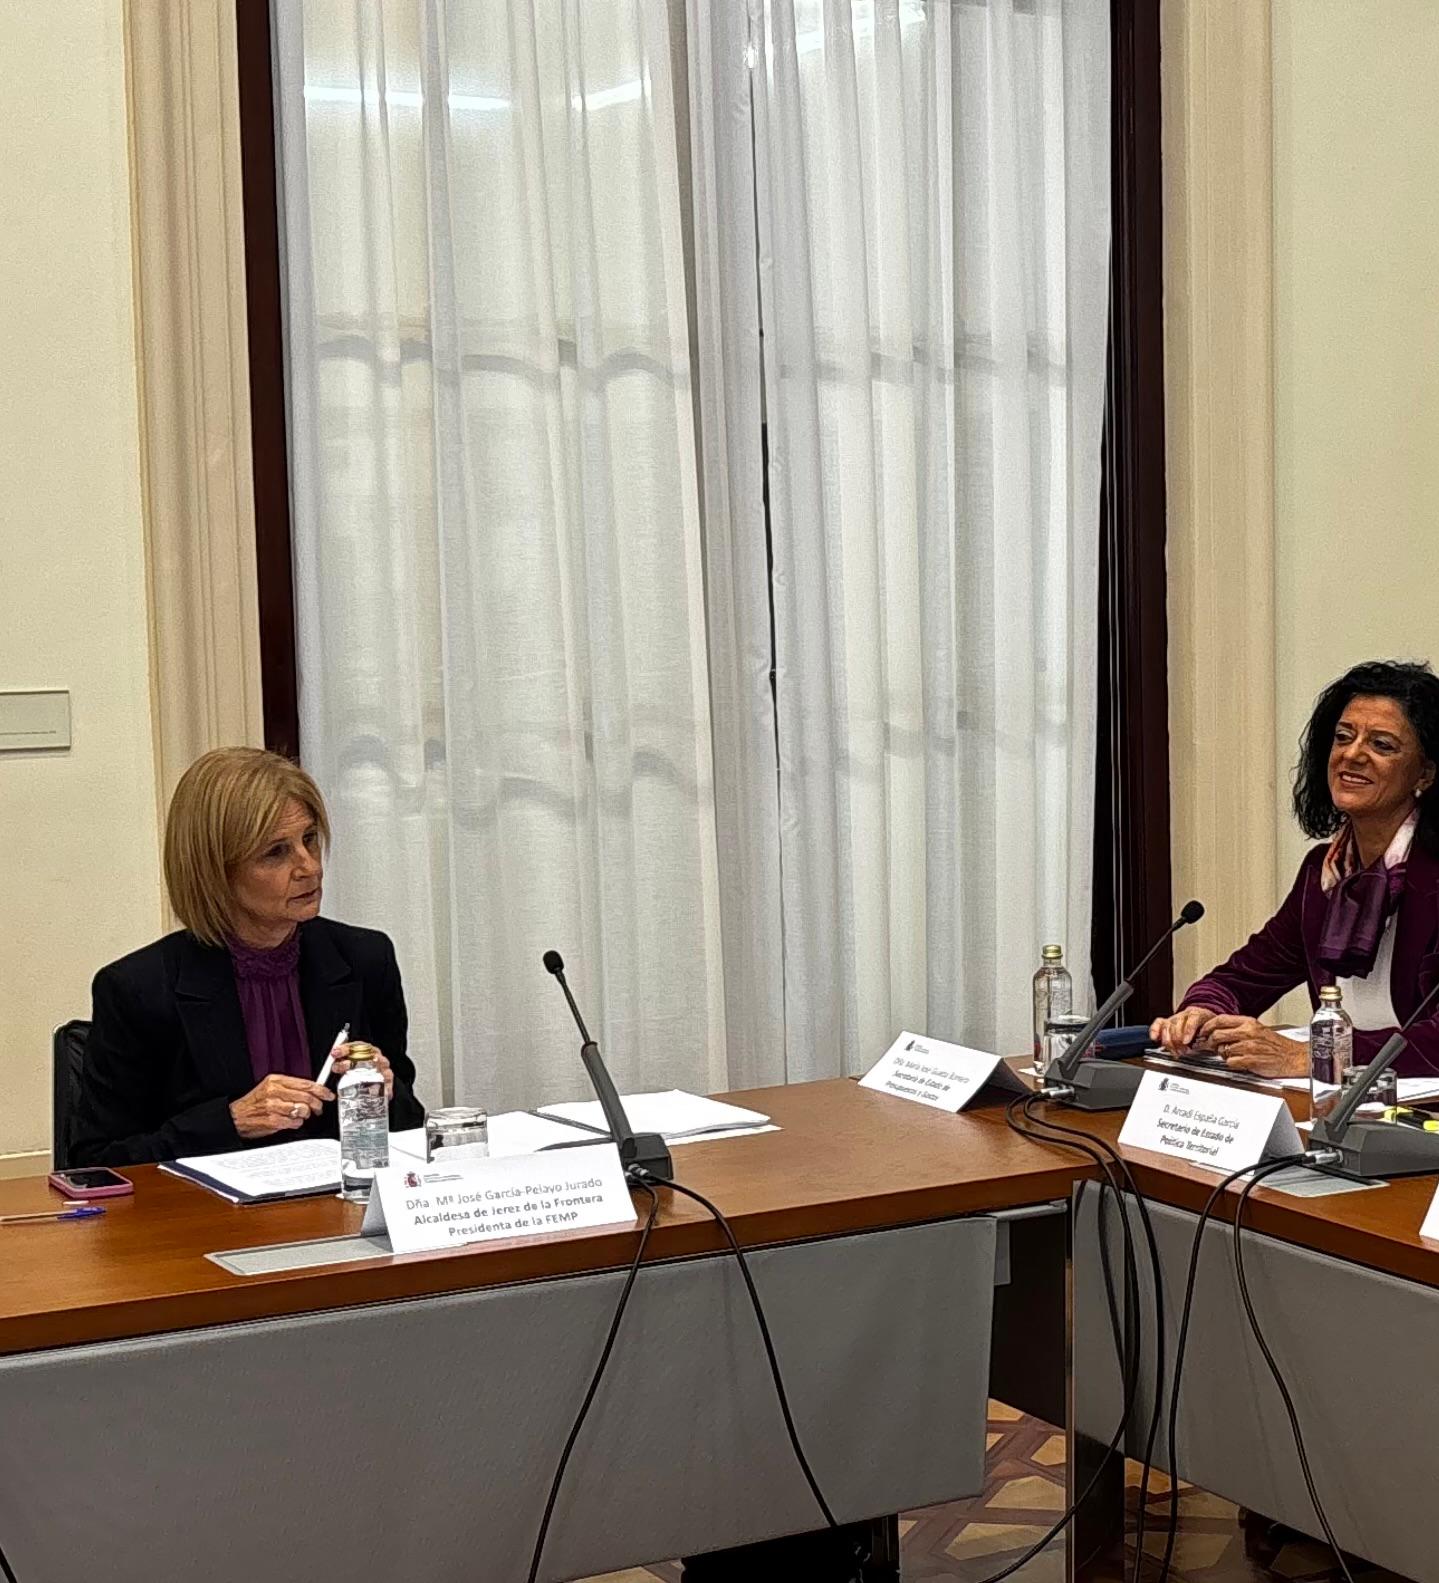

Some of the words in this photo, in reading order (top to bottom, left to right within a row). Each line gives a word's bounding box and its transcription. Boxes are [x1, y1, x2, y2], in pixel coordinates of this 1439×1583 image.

[457, 1192, 482, 1204] José
[565, 1178, 602, 1191] Jurado
[414, 1211, 470, 1225] Alcaldesa
[474, 1208, 488, 1217] de
[492, 1204, 520, 1217] Jerez
[524, 1202, 537, 1211] de
[541, 1200, 551, 1209] la
[554, 1194, 603, 1207] Frontera
[449, 1221, 512, 1236] Presidenta
[515, 1219, 529, 1228] de
[532, 1216, 543, 1226] la
[546, 1211, 578, 1225] FEMP
